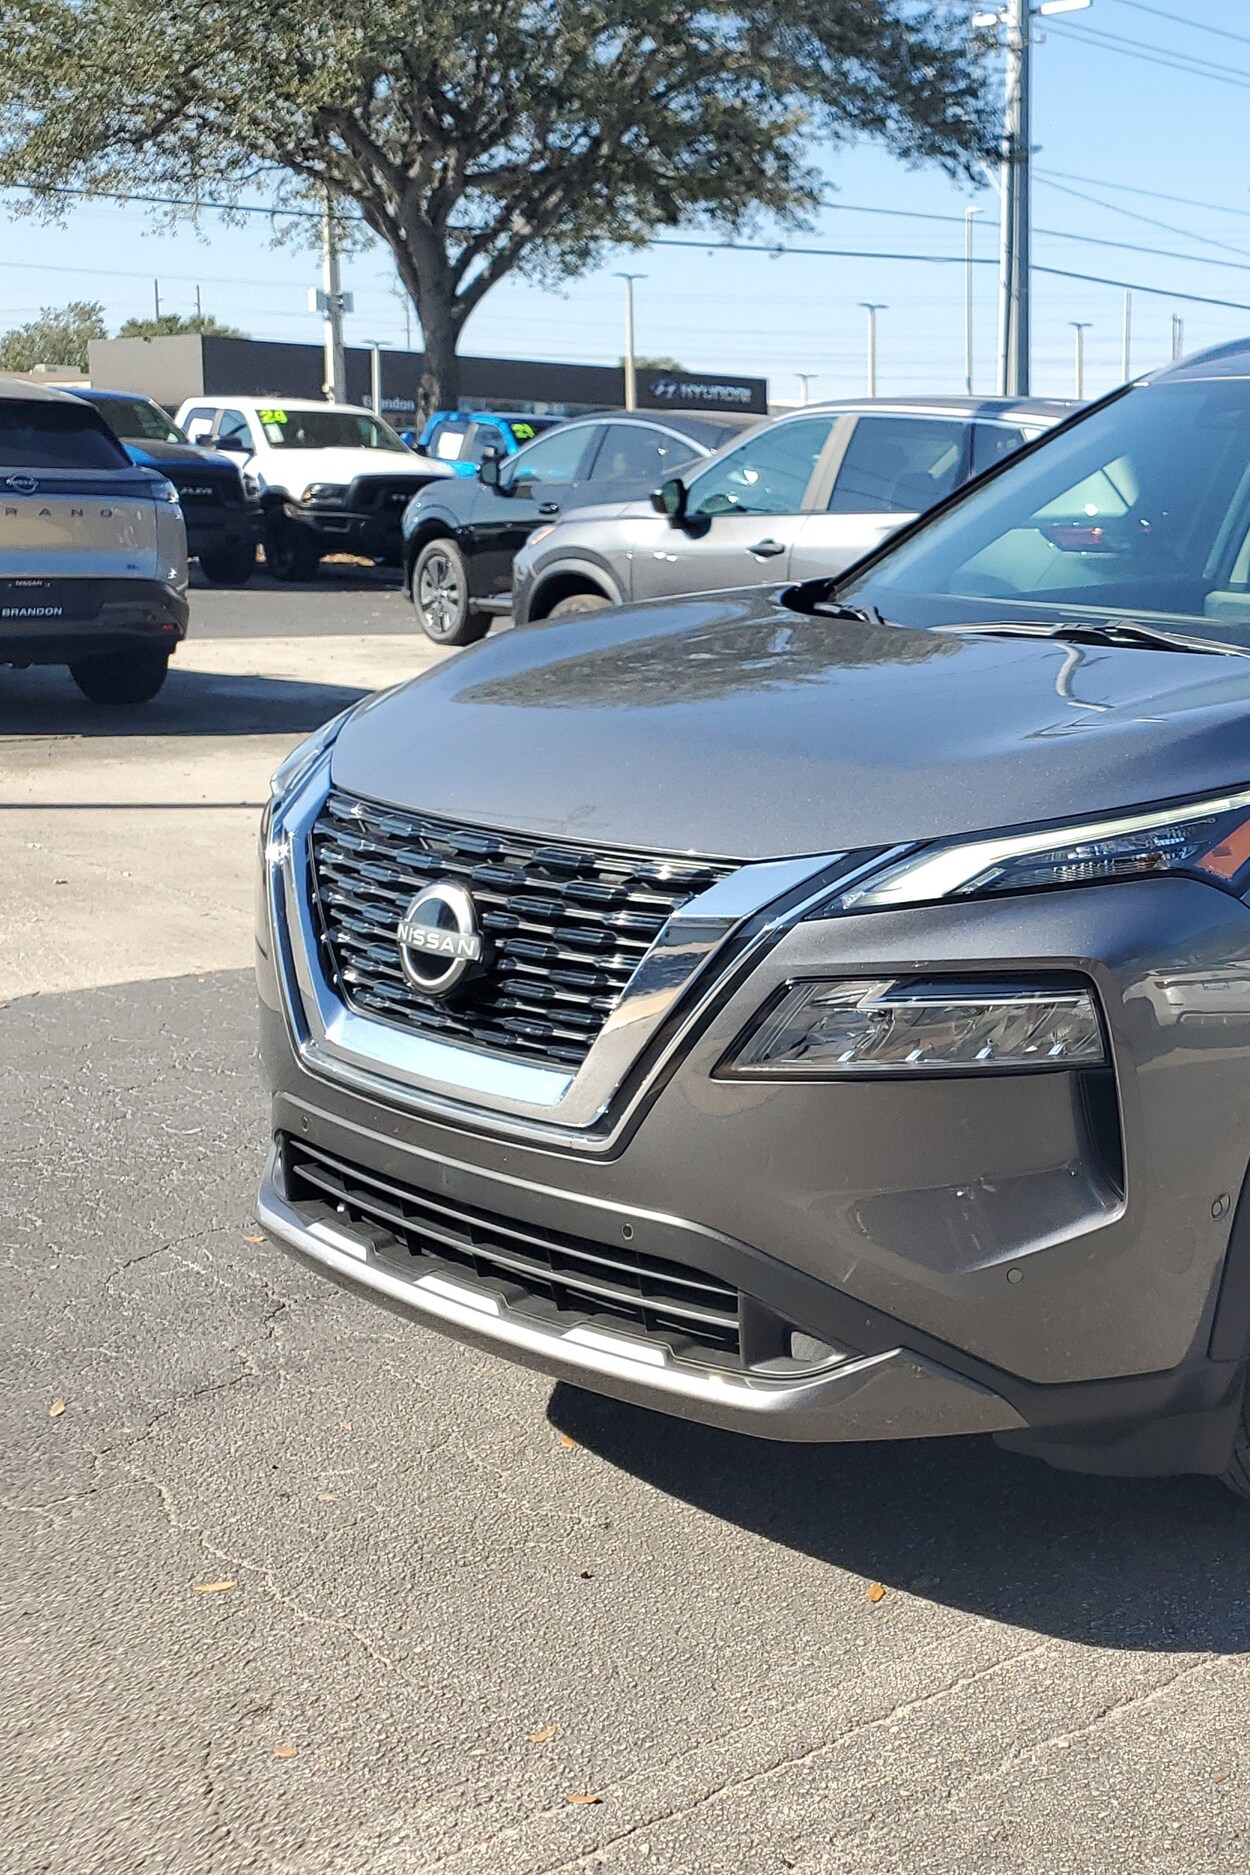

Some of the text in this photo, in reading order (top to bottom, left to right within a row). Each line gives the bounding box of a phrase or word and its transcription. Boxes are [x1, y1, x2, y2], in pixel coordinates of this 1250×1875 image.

[361, 394, 415, 411] Bndon
[2, 607, 63, 617] BRANDON
[397, 923, 475, 955] NISSAN
